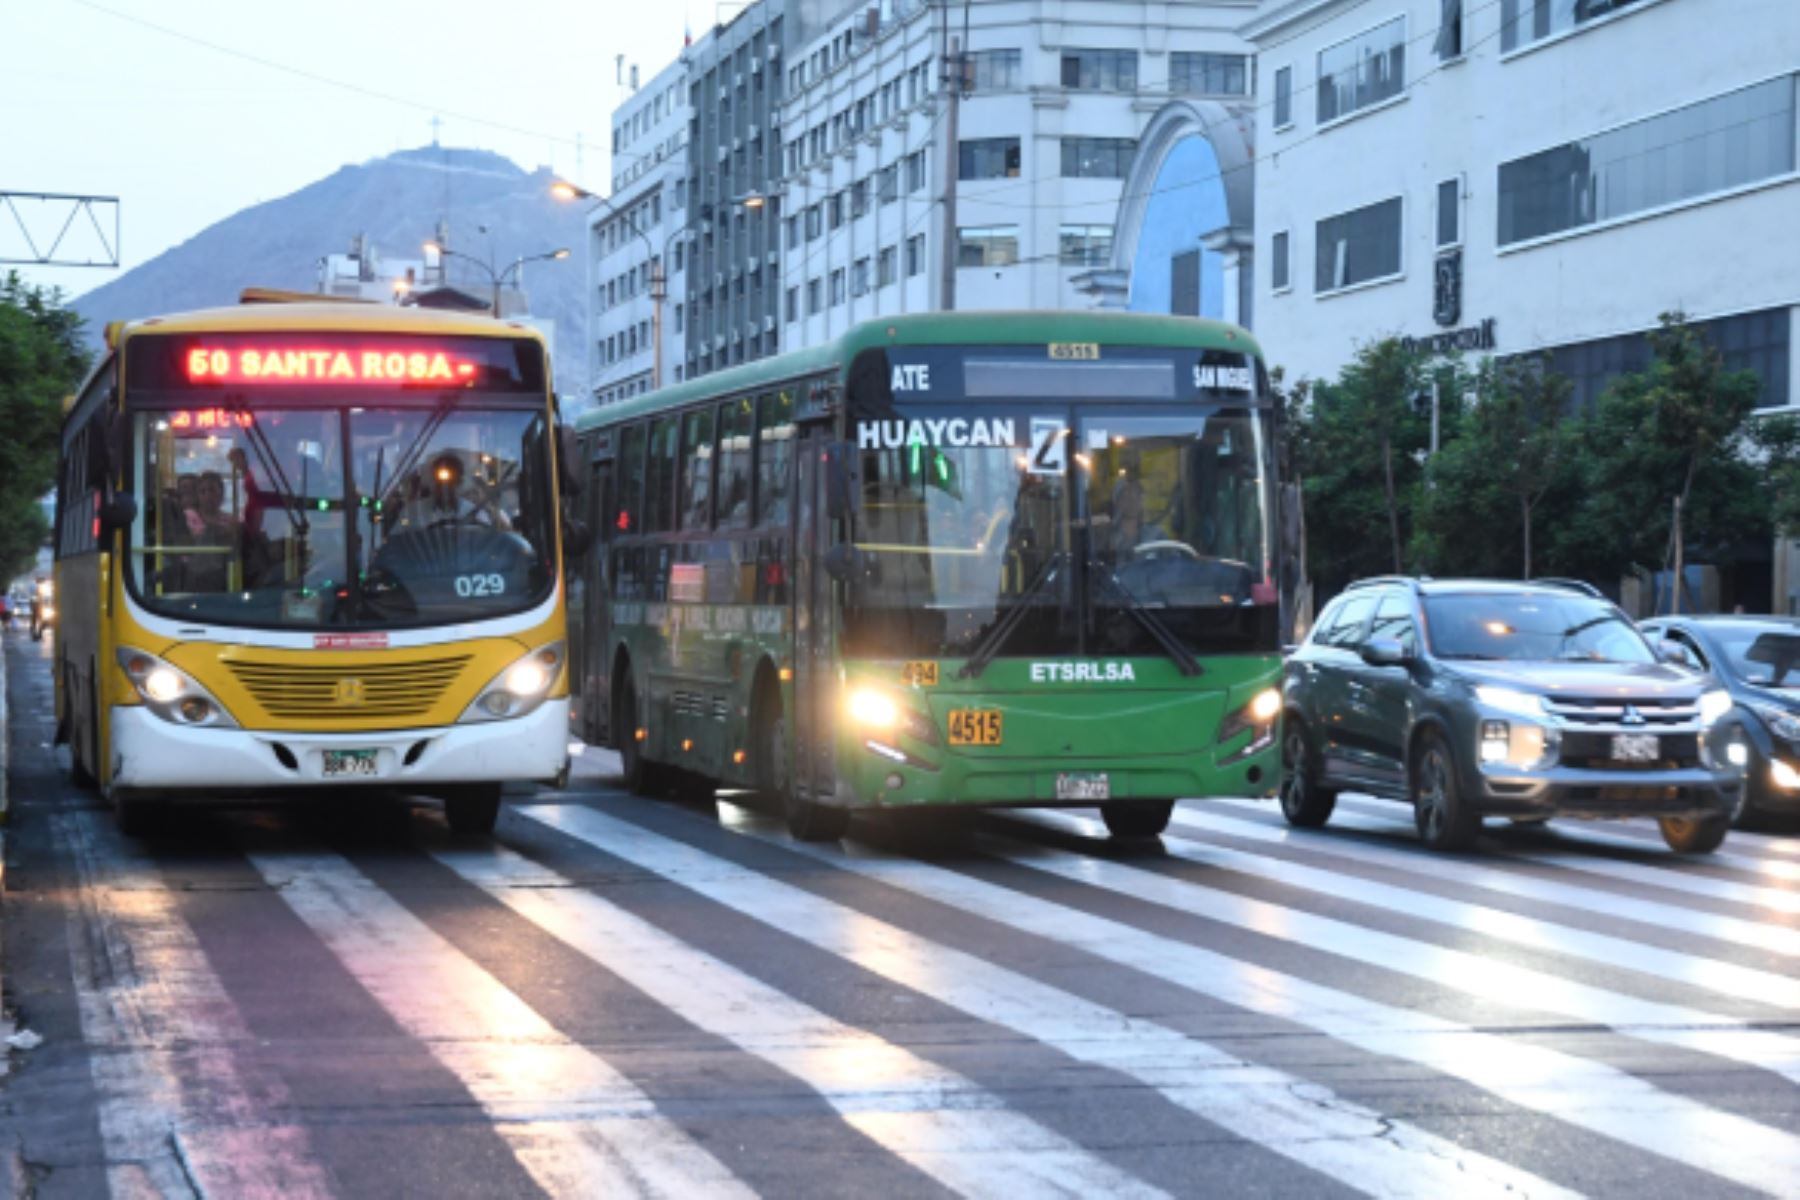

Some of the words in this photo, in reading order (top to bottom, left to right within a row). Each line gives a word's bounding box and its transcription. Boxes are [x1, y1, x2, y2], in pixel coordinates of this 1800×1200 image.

[240, 350, 354, 378] SANTA
[361, 351, 453, 379] ROSA
[891, 364, 930, 392] ATE
[858, 418, 1015, 449] HUAYCAN
[454, 573, 505, 597] 029
[1029, 662, 1135, 682] ETSRLSA
[951, 712, 1000, 743] 4515
